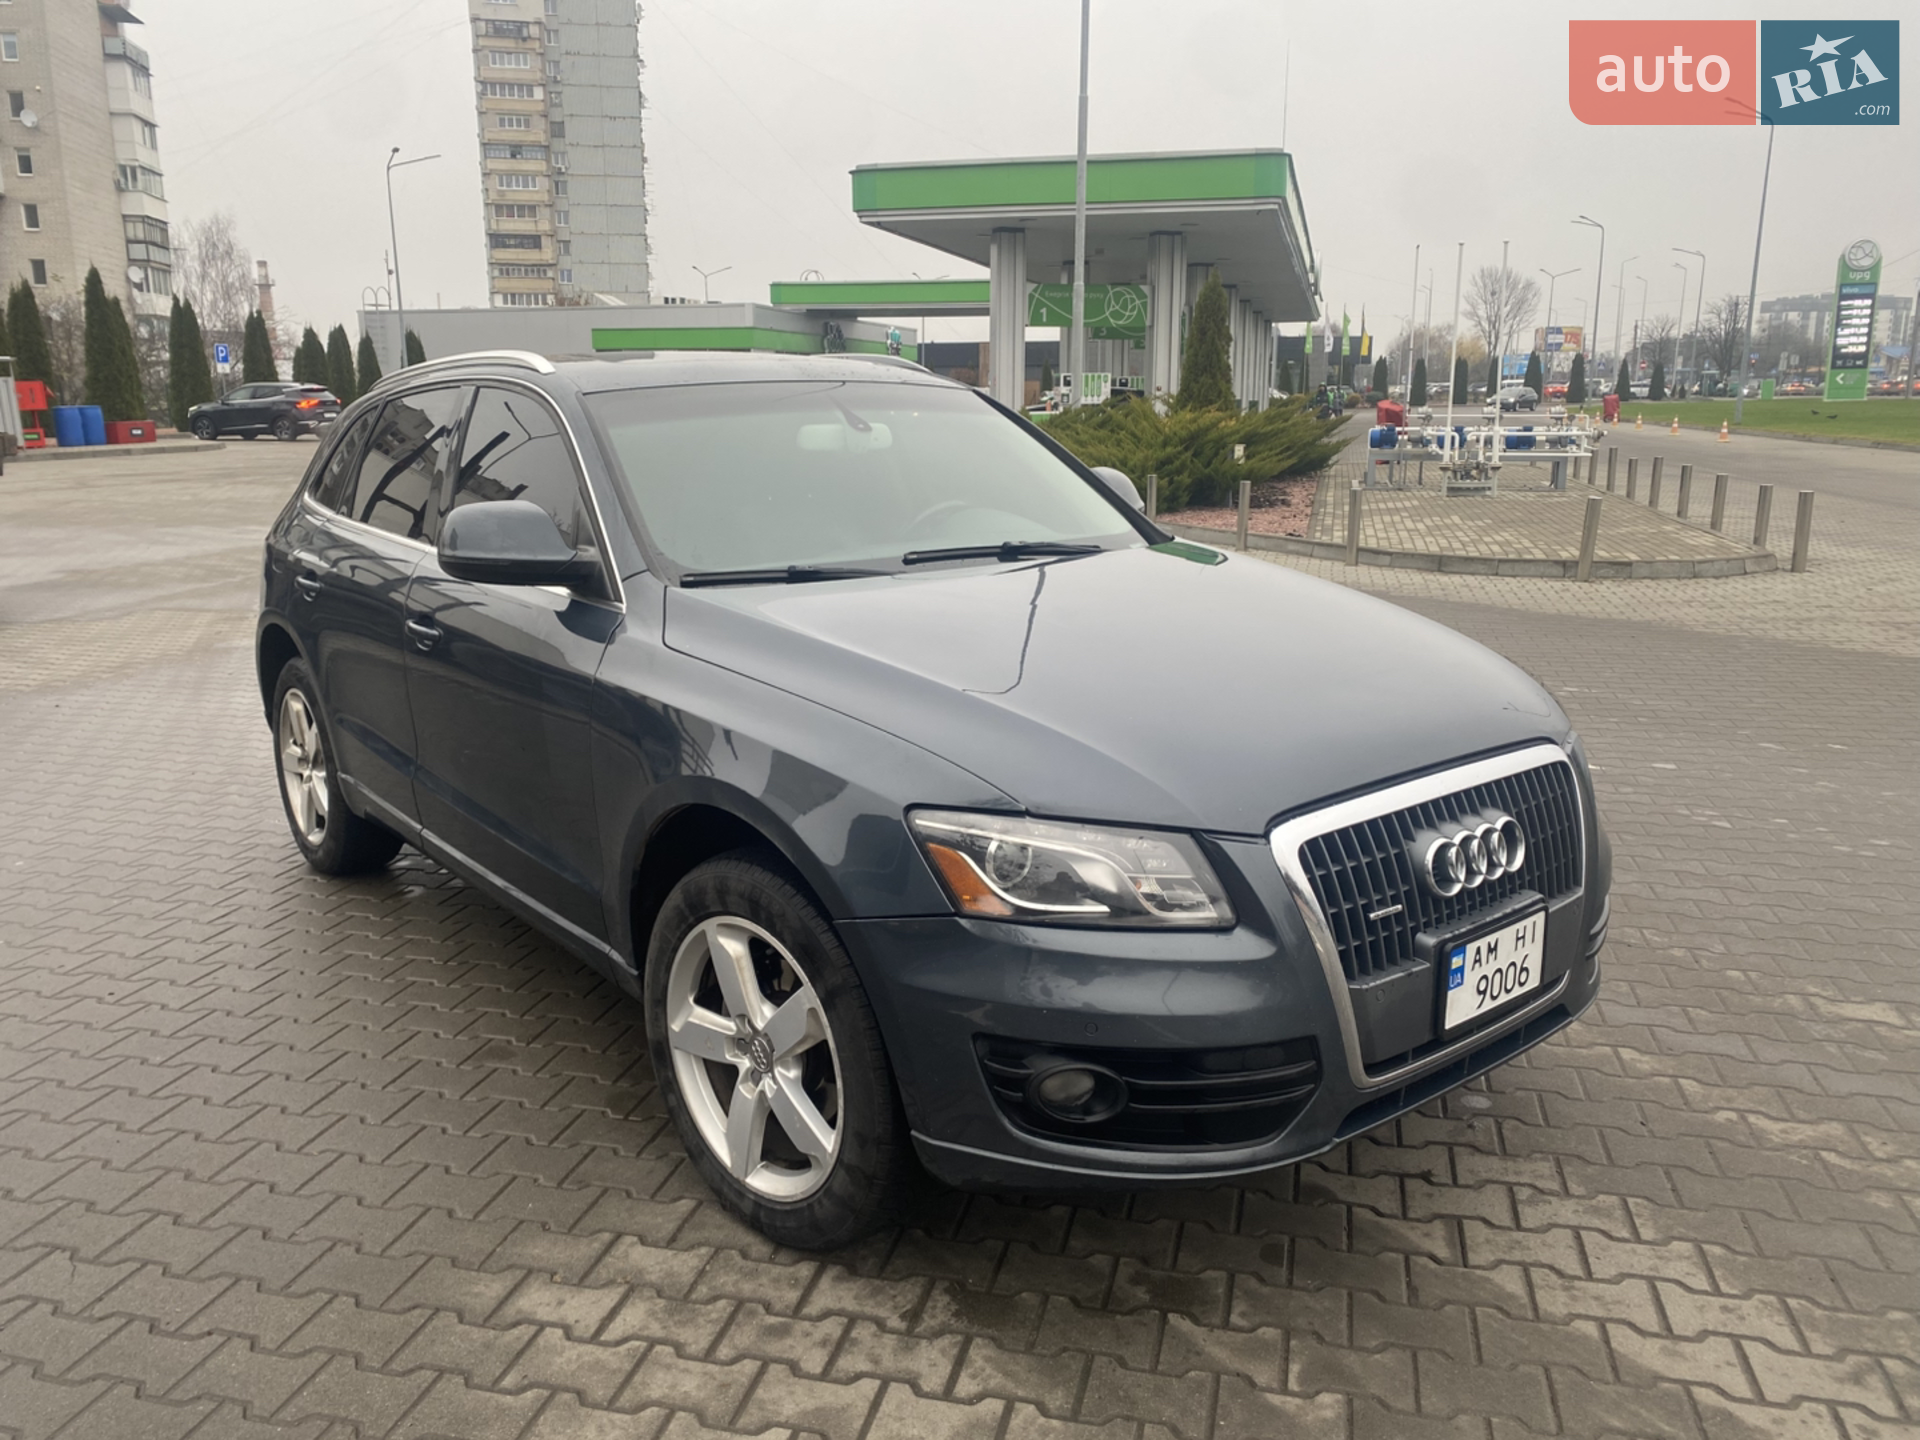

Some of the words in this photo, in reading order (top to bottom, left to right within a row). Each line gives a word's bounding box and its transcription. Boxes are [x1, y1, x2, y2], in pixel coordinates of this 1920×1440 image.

[1849, 271, 1871, 281] upg
[1039, 307, 1047, 322] 1
[218, 346, 226, 361] P
[1471, 937, 1499, 972] AM
[1514, 920, 1536, 952] HI
[1449, 972, 1462, 988] UA
[1475, 953, 1530, 1010] 9006
